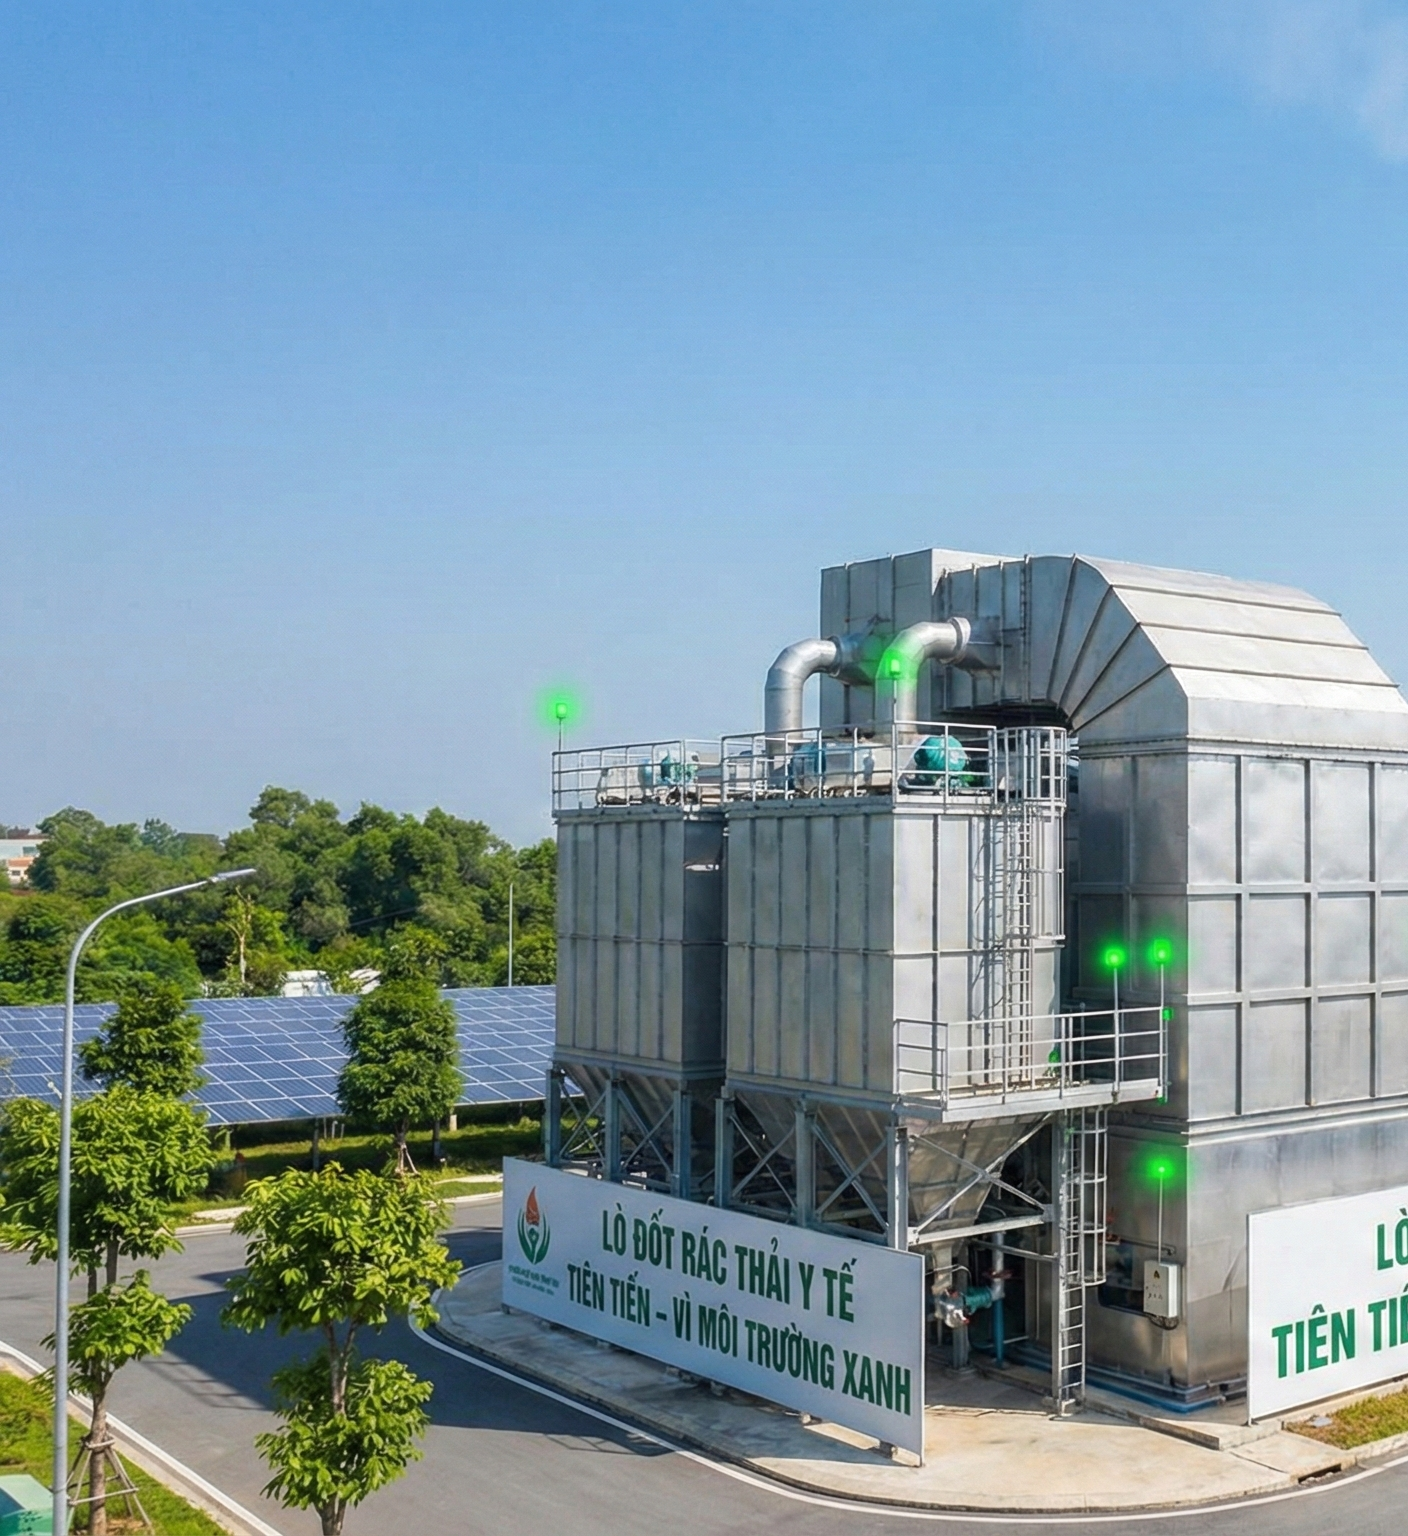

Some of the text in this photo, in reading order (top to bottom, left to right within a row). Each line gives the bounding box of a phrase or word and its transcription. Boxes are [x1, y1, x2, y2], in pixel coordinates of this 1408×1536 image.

[602, 1202, 858, 1324] LÒ ĐỐT RÁC THẢI Y TẾ
[567, 1261, 605, 1312] TIÊN
[609, 1270, 651, 1328] TIẾN
[672, 1292, 692, 1343] VÌ
[697, 1303, 739, 1359] MÔI
[744, 1320, 835, 1391] TRƯỜNG
[841, 1349, 912, 1417] XANH
[1271, 1304, 1357, 1378] TIÊN
